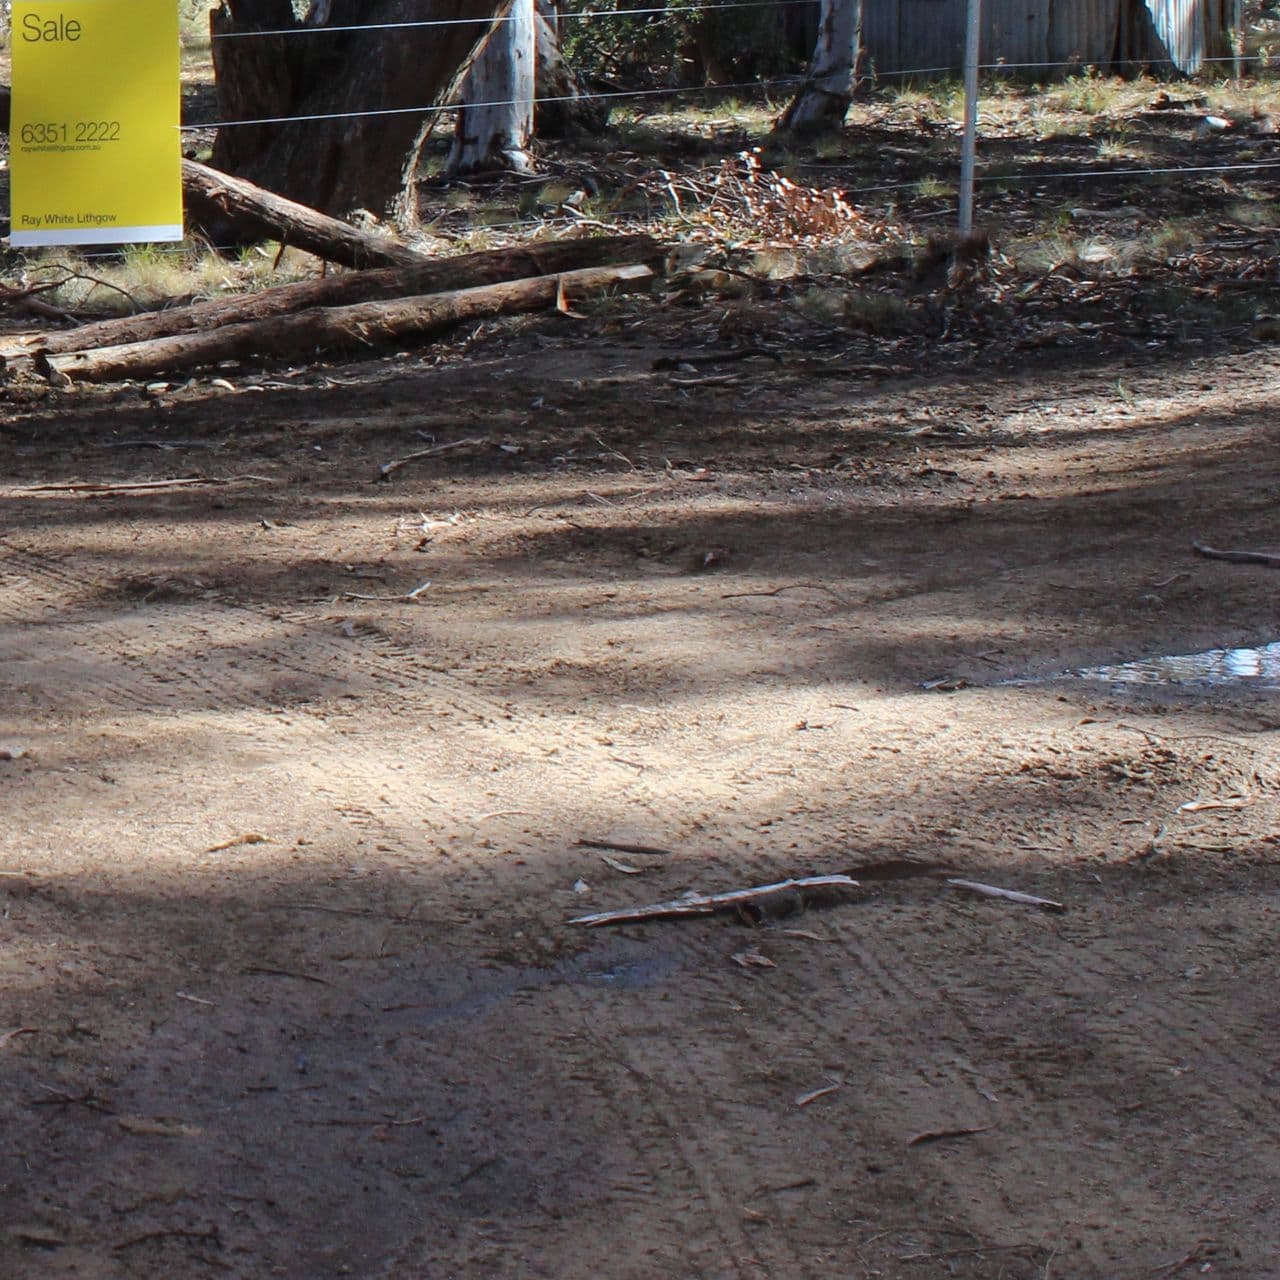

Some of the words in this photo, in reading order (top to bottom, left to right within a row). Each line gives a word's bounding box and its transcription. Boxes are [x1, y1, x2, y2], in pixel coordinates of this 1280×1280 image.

[22, 13, 81, 42] Sale
[21, 123, 66, 143] 6351
[75, 121, 120, 142] 2222
[21, 215, 41, 226] Ray
[45, 214, 74, 224] White
[77, 213, 116, 225] Lithgow
